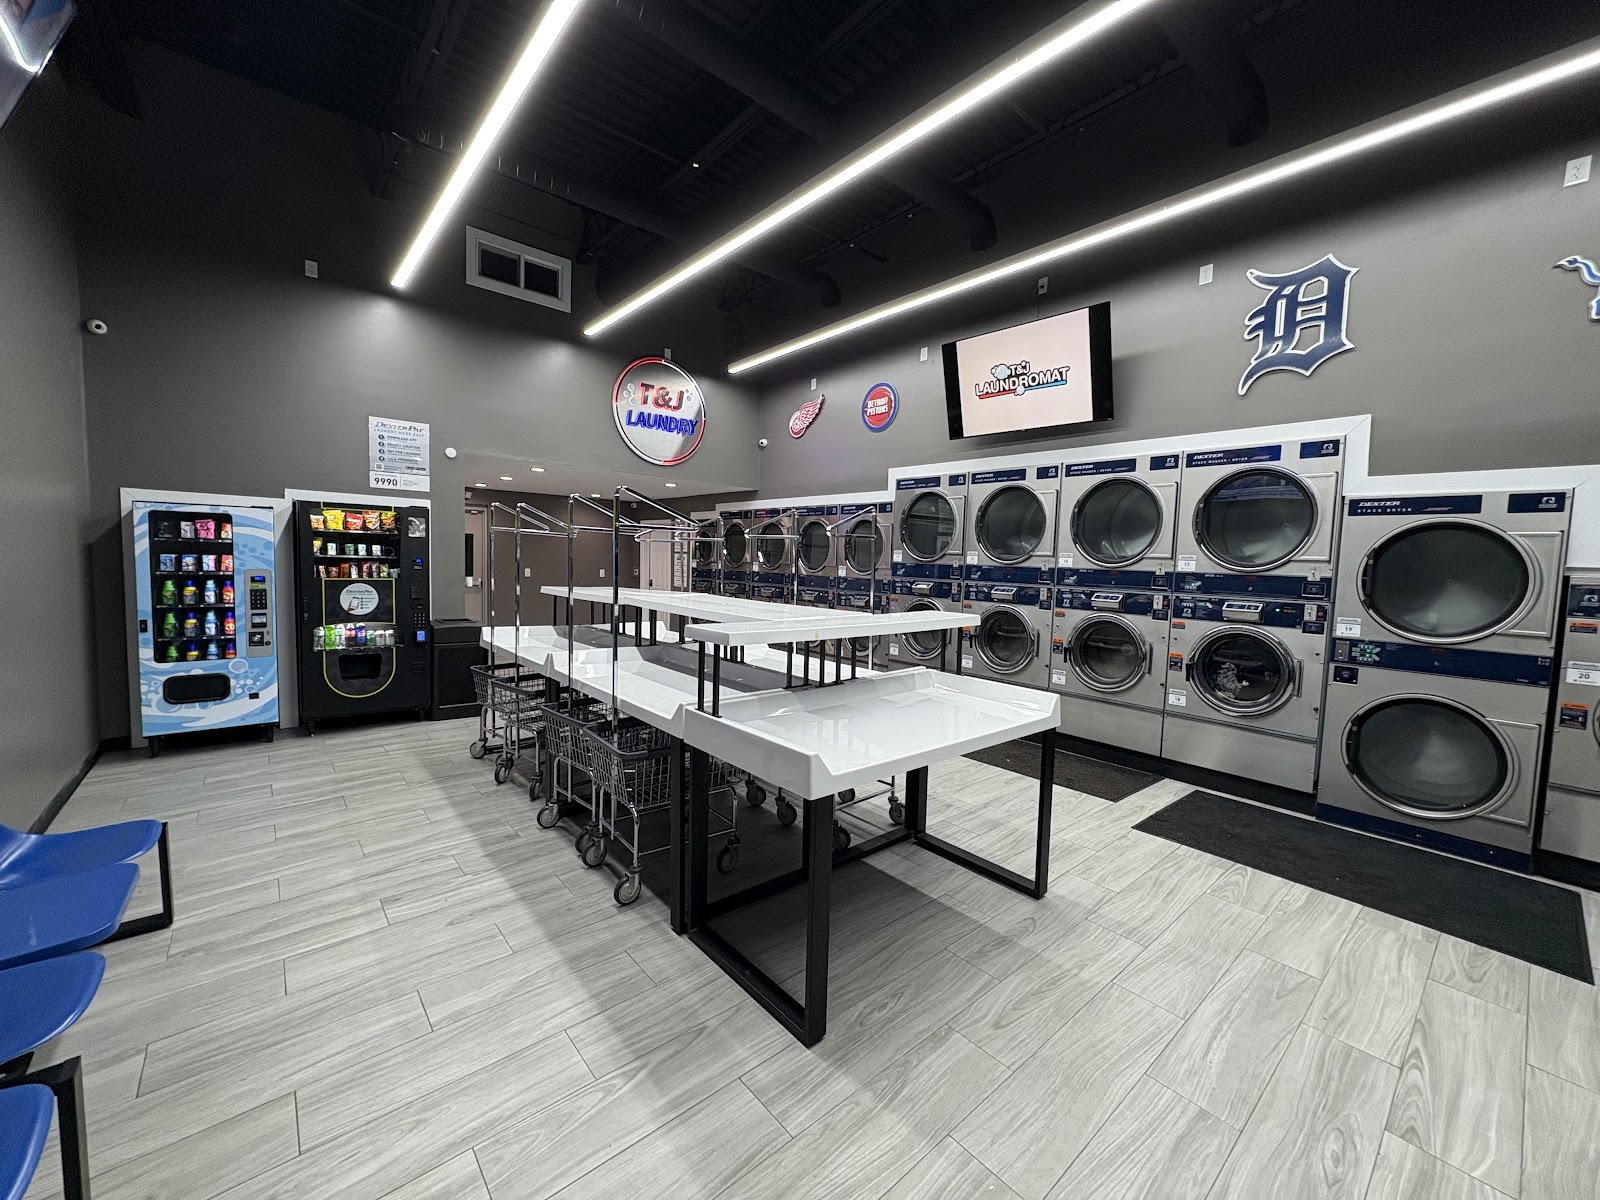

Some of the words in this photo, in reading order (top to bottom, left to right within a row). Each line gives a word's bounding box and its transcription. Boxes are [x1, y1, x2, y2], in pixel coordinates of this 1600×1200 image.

[1009, 361, 1031, 376] T&J
[975, 366, 1070, 397] LAUNDROMAT
[638, 382, 685, 412] T&J
[867, 396, 889, 408] DETROIT
[867, 405, 889, 416] PISTONS
[625, 409, 699, 436] LAUNDRY
[374, 477, 398, 487] 9990
